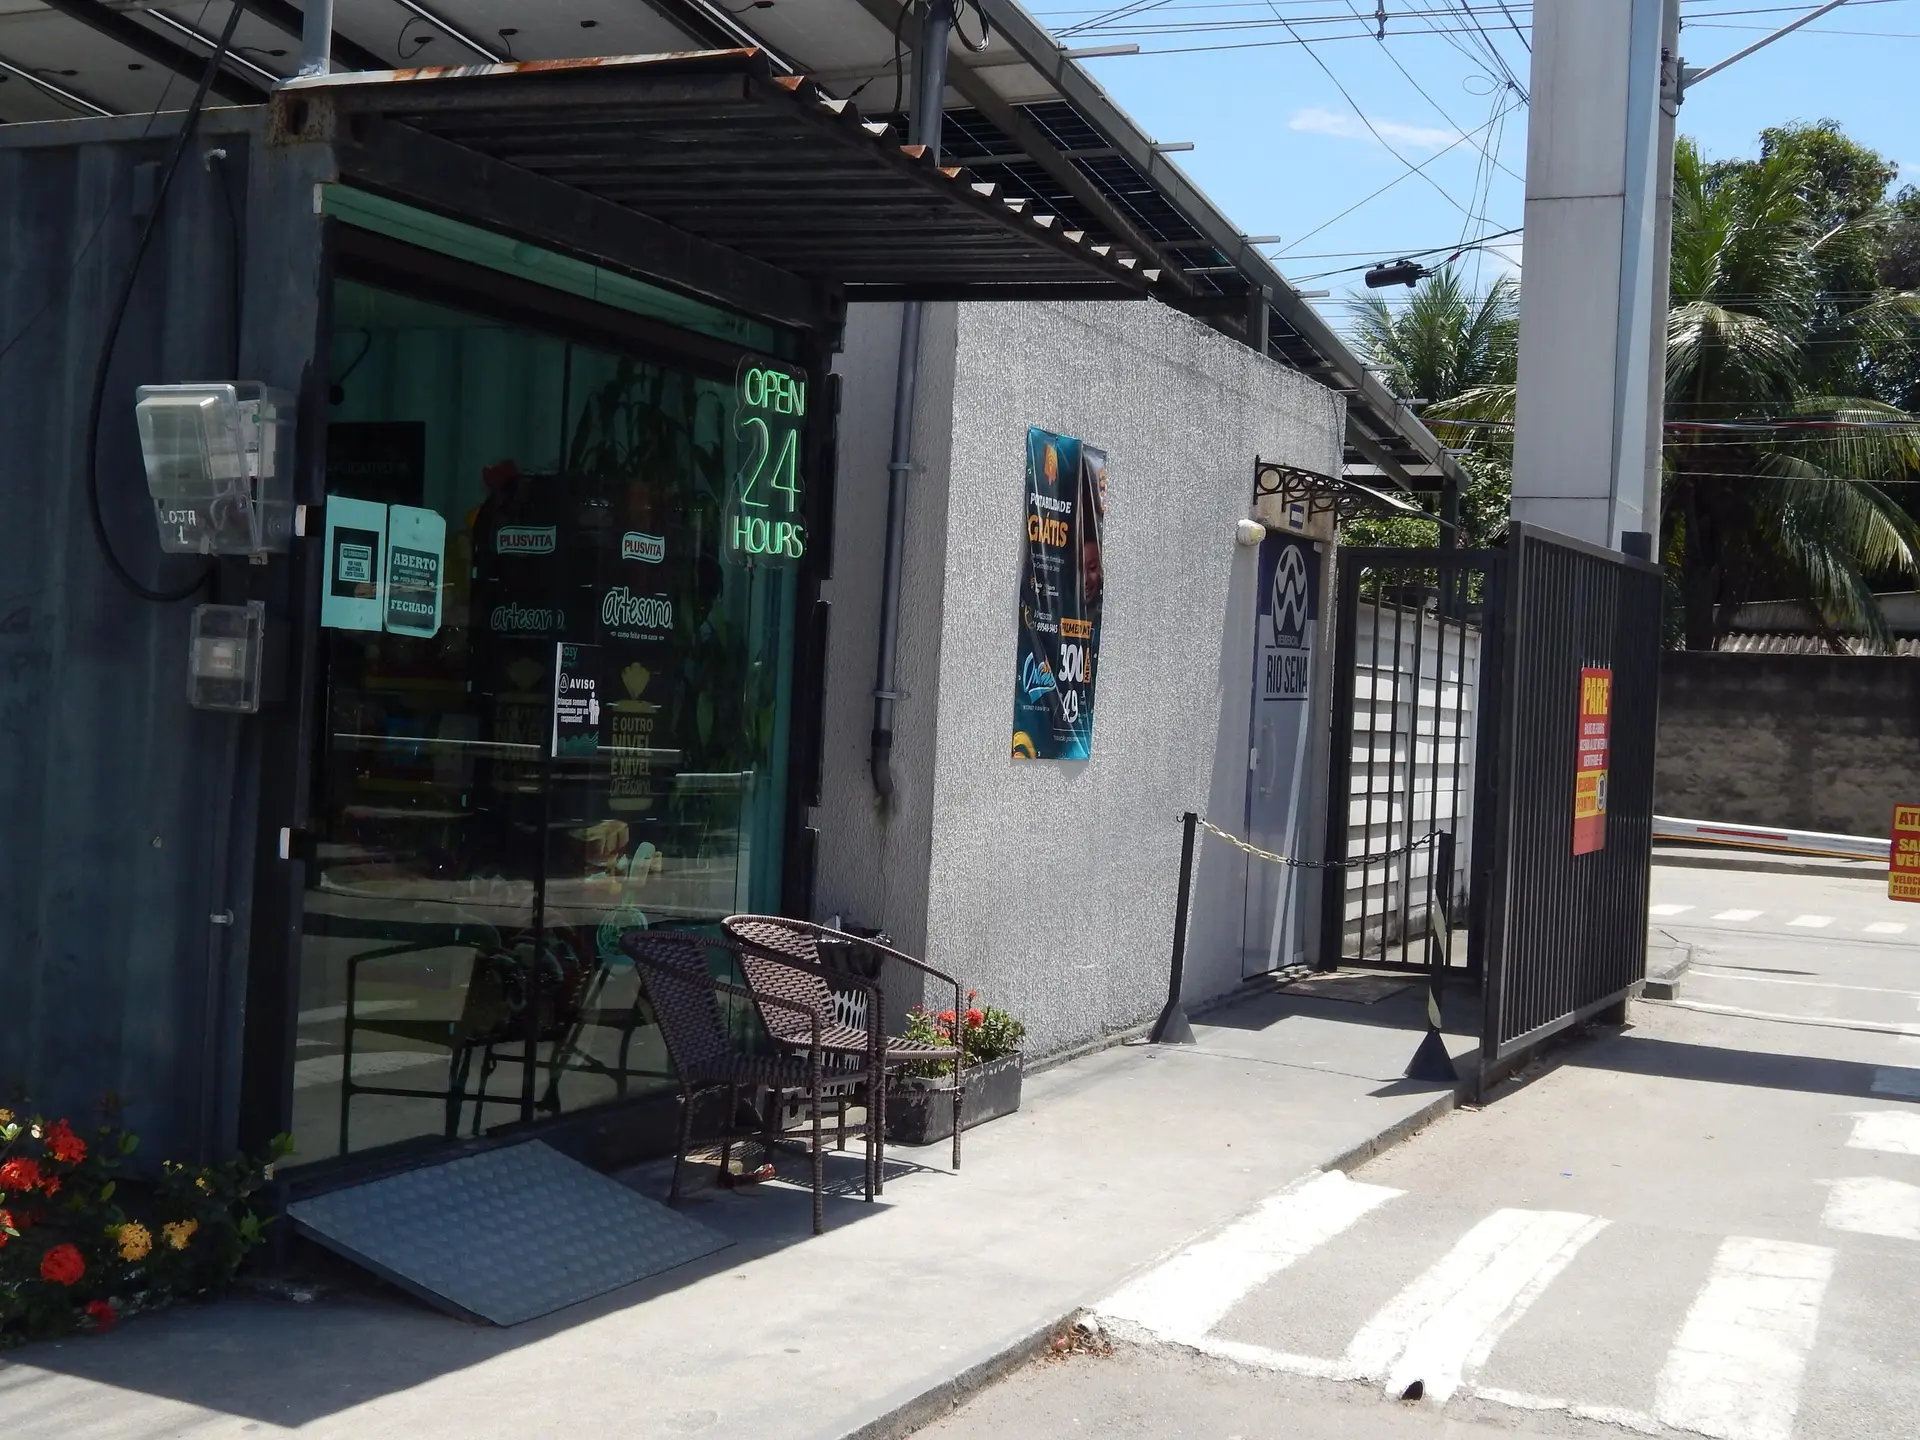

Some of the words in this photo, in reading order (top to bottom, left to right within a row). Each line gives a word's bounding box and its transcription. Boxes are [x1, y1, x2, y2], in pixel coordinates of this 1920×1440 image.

[744, 367, 805, 416] OPEN
[741, 417, 802, 512] 24
[160, 510, 197, 526] LOJA
[1028, 512, 1069, 548] GRÁTIS
[499, 534, 553, 548] PLUSVITA
[624, 539, 662, 557] PLUSVITA
[733, 515, 804, 558] HOURS
[393, 552, 437, 572] ABERTO
[390, 599, 434, 615] FECHADO
[1058, 643, 1084, 682] 300
[1266, 655, 1282, 693] RIO
[1284, 655, 1308, 693] SENA
[569, 678, 595, 690] AVISO
[1583, 677, 1609, 715] PARE
[620, 717, 653, 732] OUTRO
